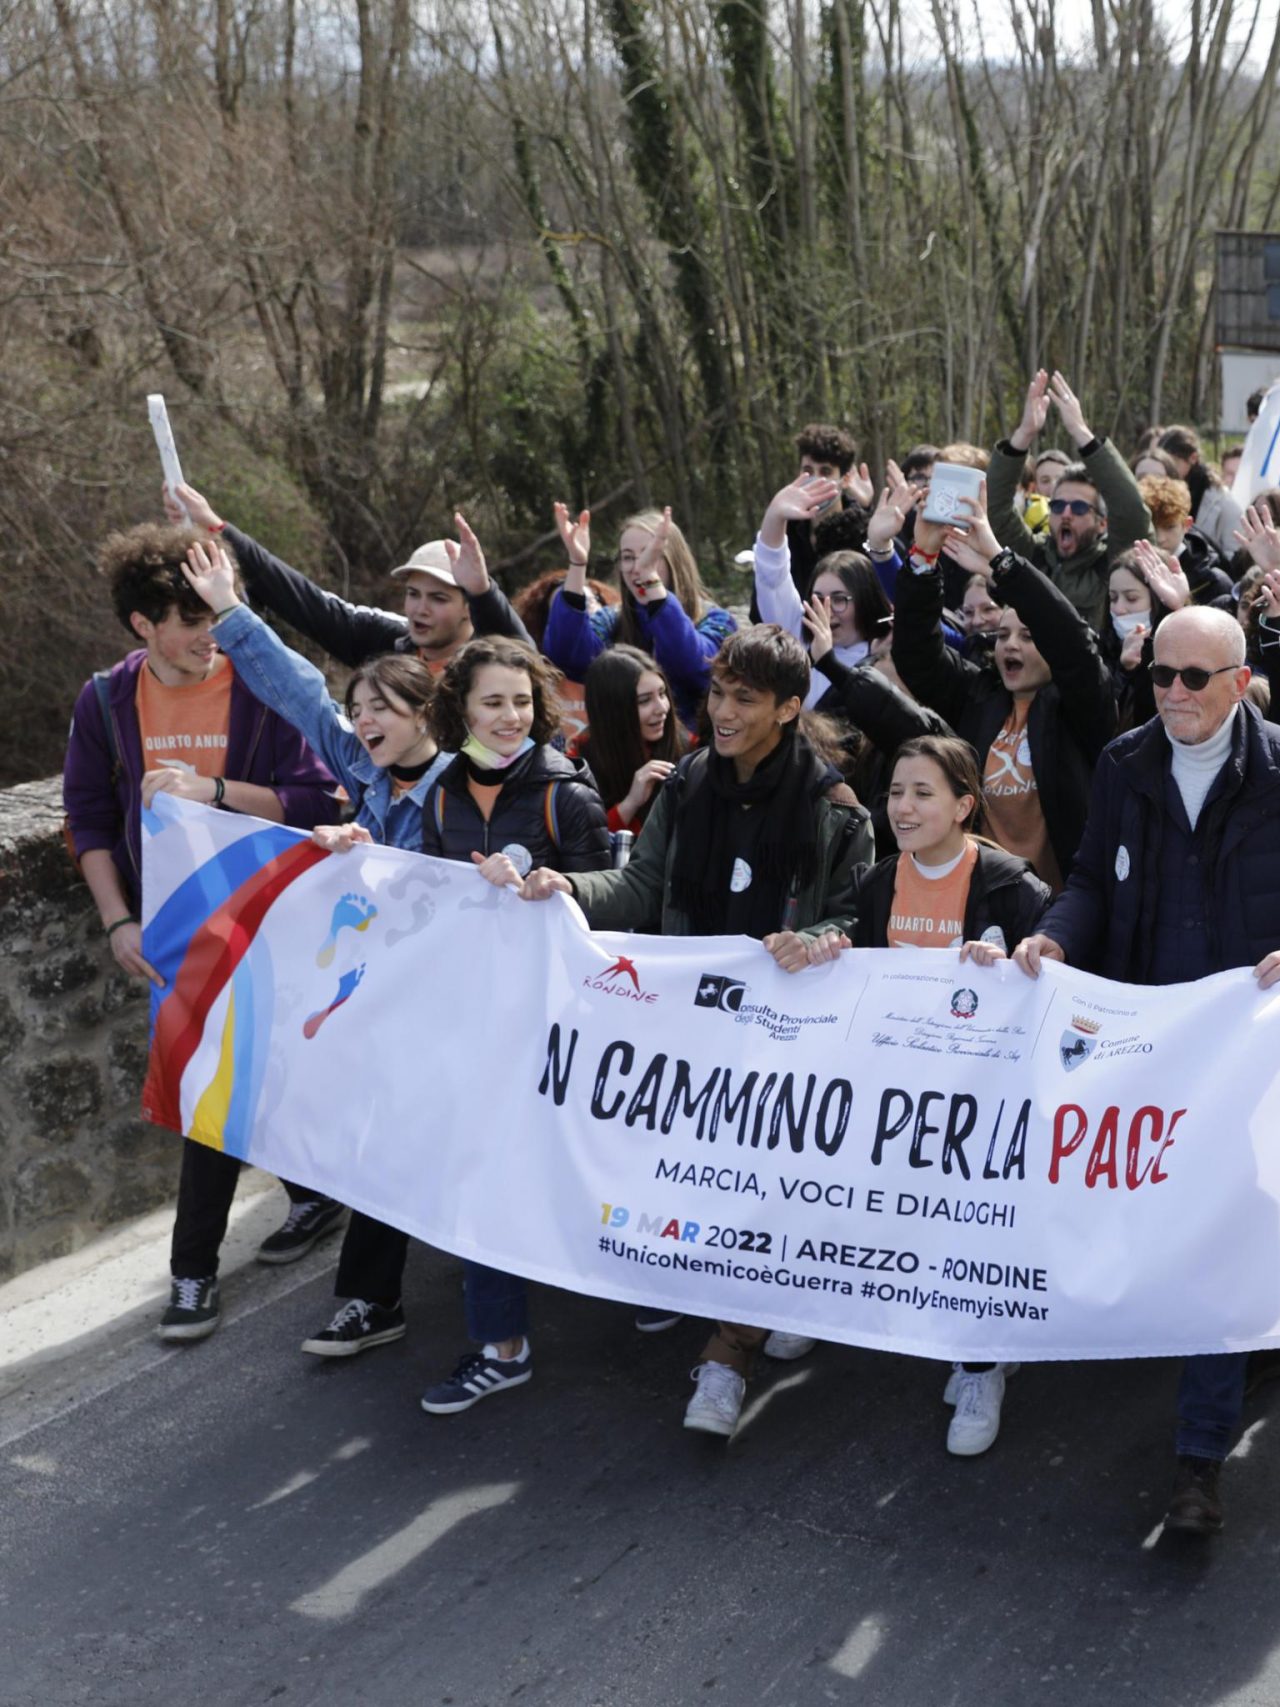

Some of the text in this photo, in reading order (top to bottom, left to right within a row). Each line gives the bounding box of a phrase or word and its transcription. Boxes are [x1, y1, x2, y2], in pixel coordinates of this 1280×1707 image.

[145, 734, 228, 750] QUARTO ANNO
[890, 915, 962, 934] QUARTO ANN
[583, 976, 659, 1004] RONDINE
[755, 1015, 801, 1035] Studenti
[779, 1013, 838, 1025] Provinciale
[1100, 1035, 1140, 1049] Comune
[1107, 1042, 1153, 1058] AREZZO
[591, 1040, 852, 1157] CAMMINO
[871, 1087, 979, 1181] PER
[982, 1098, 1032, 1181] LA
[1048, 1103, 1188, 1191] PACE
[655, 1158, 1016, 1228] MARCIA, VOCI E DIALOGHI
[600, 1202, 630, 1229] 19
[636, 1212, 700, 1244] MAR
[704, 1224, 773, 1255] 2022
[796, 1238, 919, 1275] AREZZO
[941, 1256, 1048, 1292] RONDINE
[598, 1235, 1050, 1321] #UnicoNemicoèGuerra #OnlyEnemyisWar
